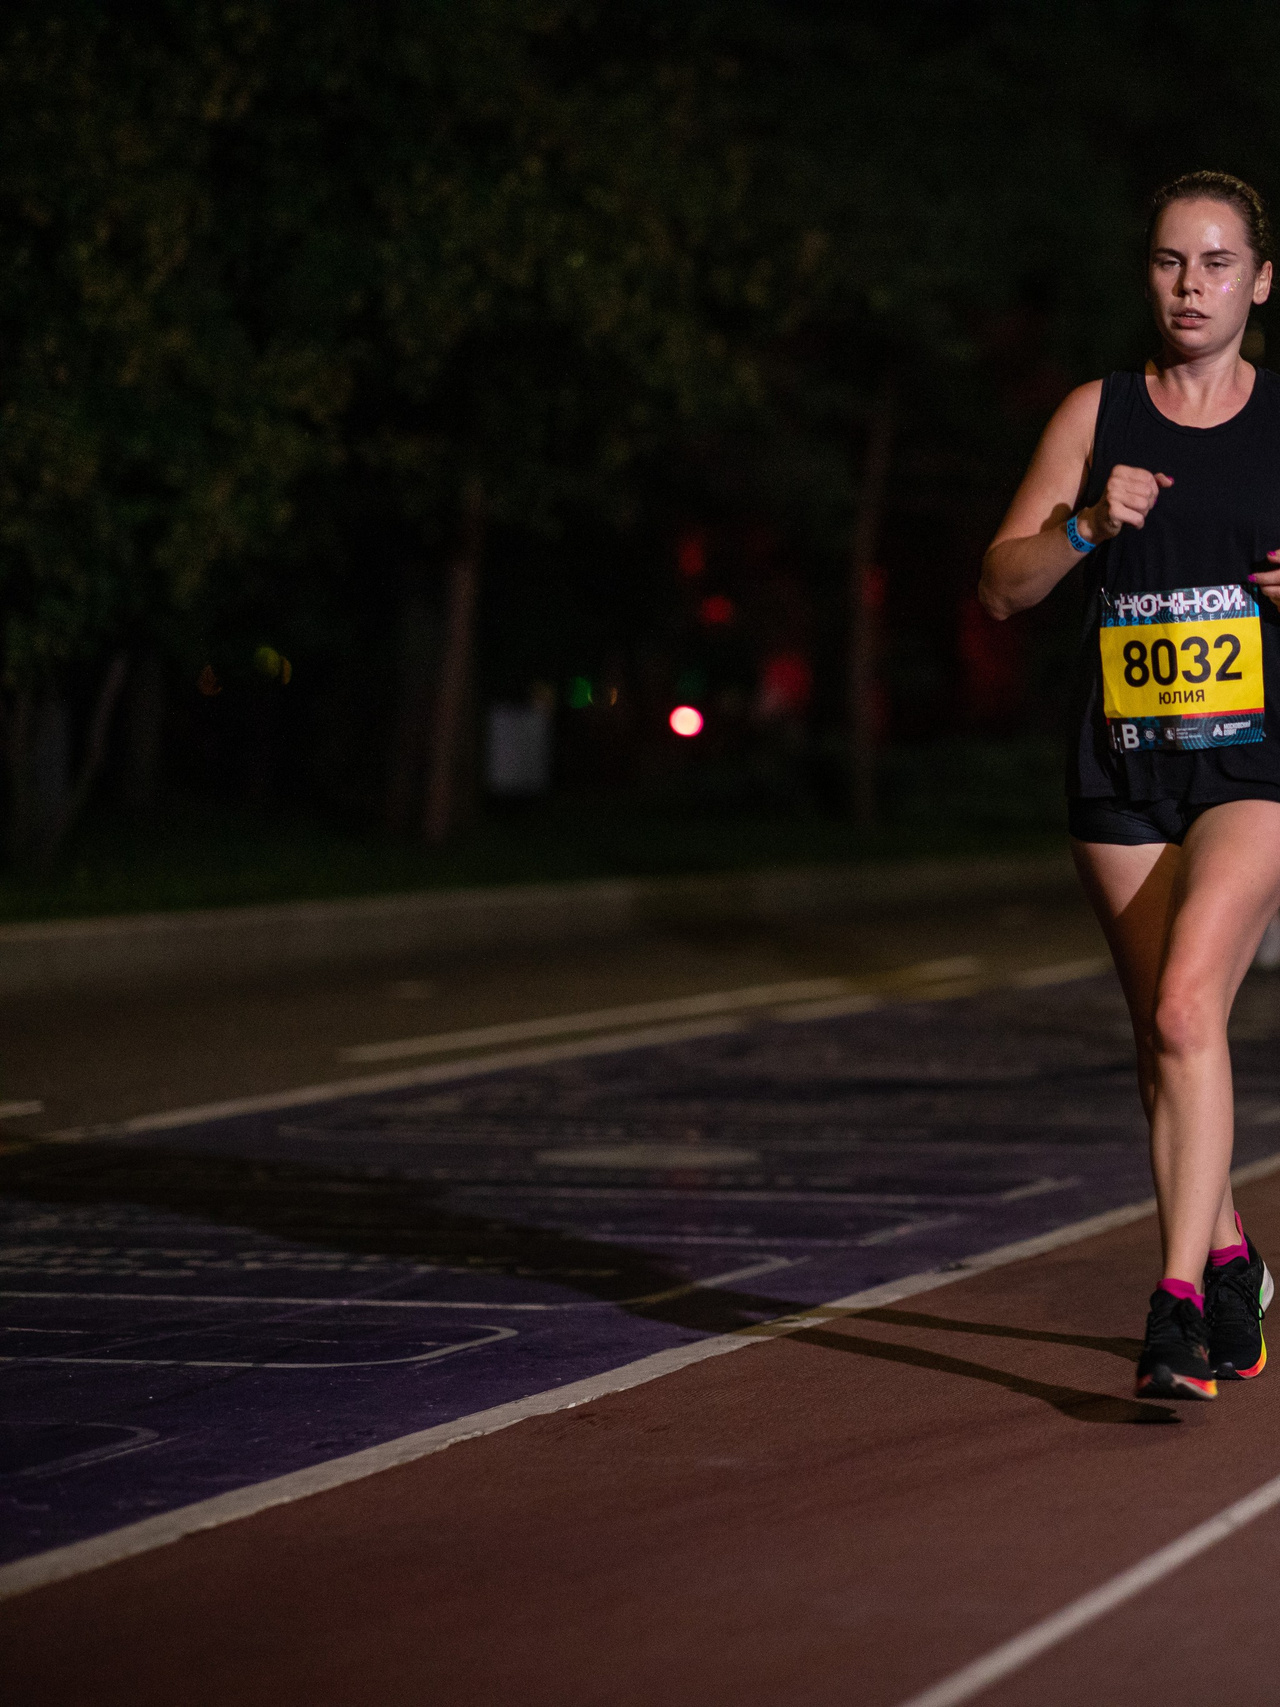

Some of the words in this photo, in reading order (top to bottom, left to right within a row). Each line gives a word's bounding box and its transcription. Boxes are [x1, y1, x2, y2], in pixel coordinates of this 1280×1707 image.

[1115, 585, 1246, 617] НОЧНОЙ
[1174, 613, 1226, 623] ЗАБЕГ
[1123, 634, 1243, 687] 8032
[1159, 690, 1205, 704] ЮЛИЯ
